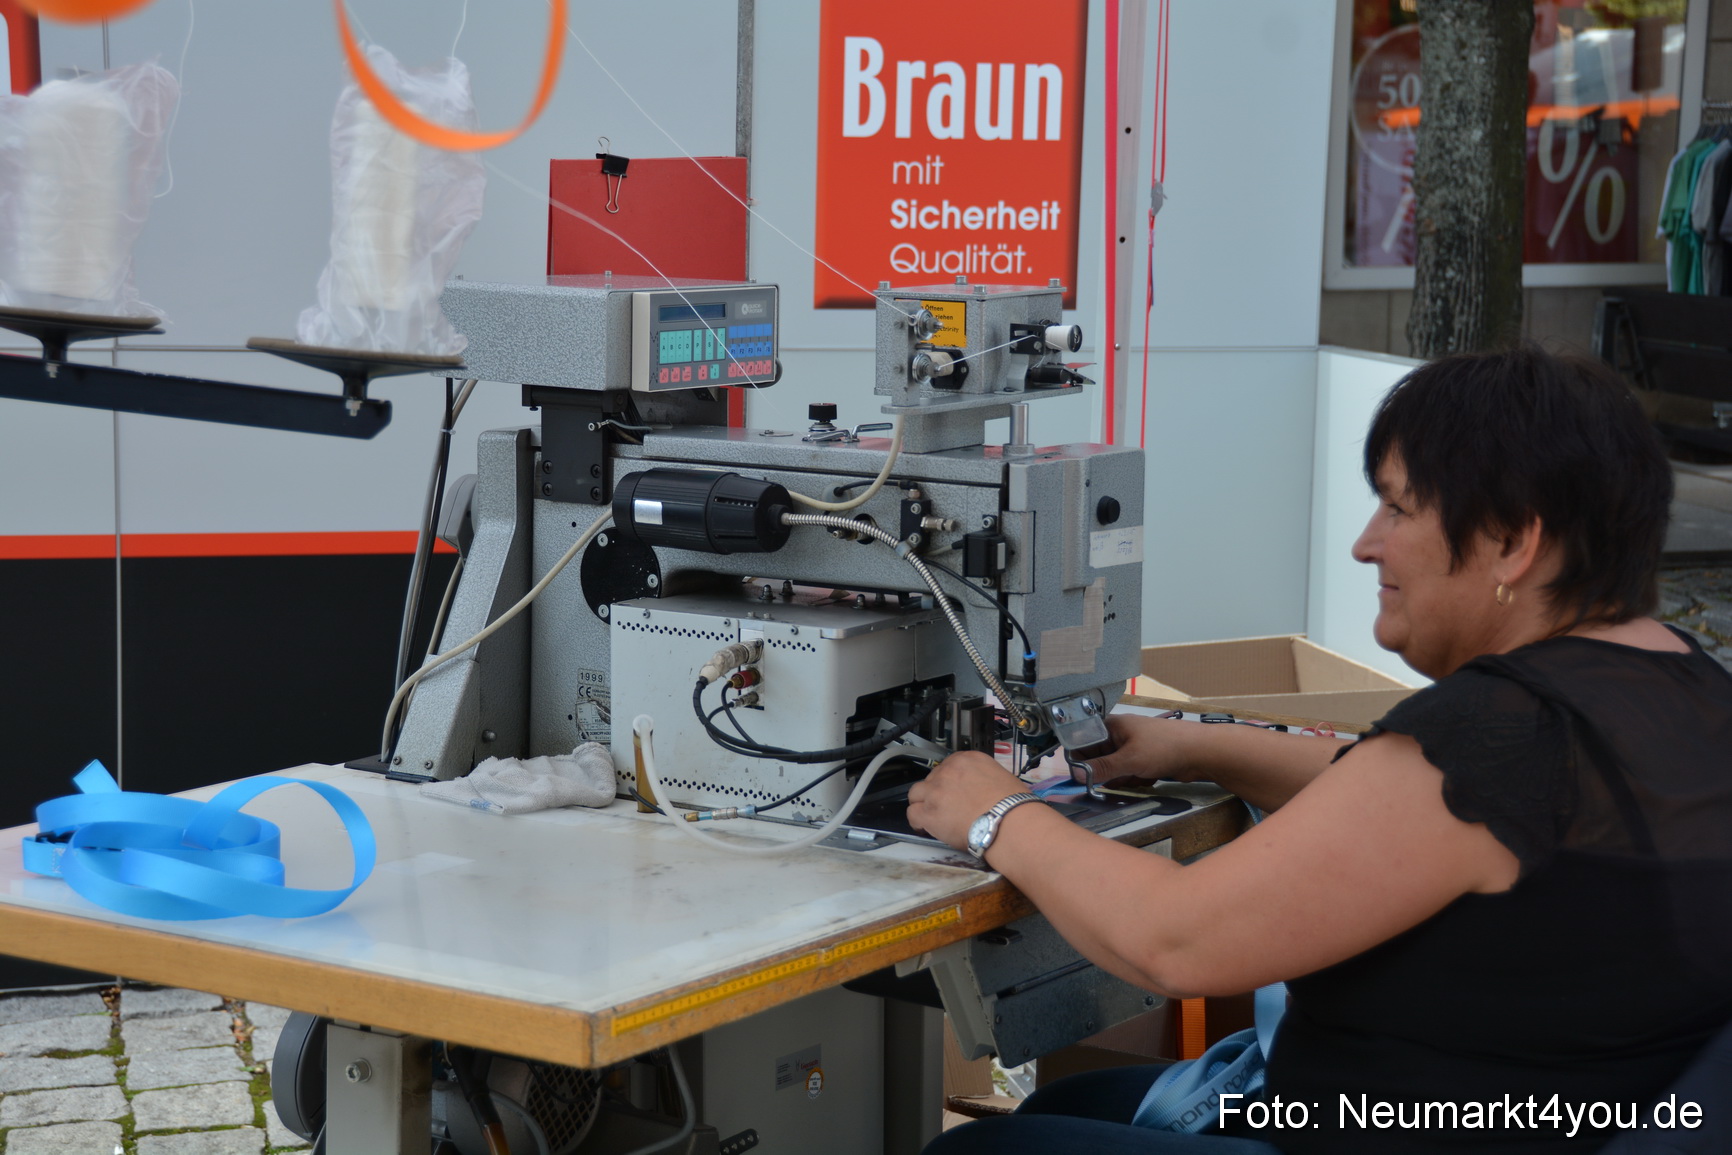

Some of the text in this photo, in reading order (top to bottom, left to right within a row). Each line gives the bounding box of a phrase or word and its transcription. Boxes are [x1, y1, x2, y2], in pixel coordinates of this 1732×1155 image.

[843, 36, 1063, 141] Braun
[893, 155, 944, 184] mit
[890, 199, 1061, 230] Sicherheit
[890, 243, 1032, 274] Qualität.
[580, 672, 603, 683] 1999
